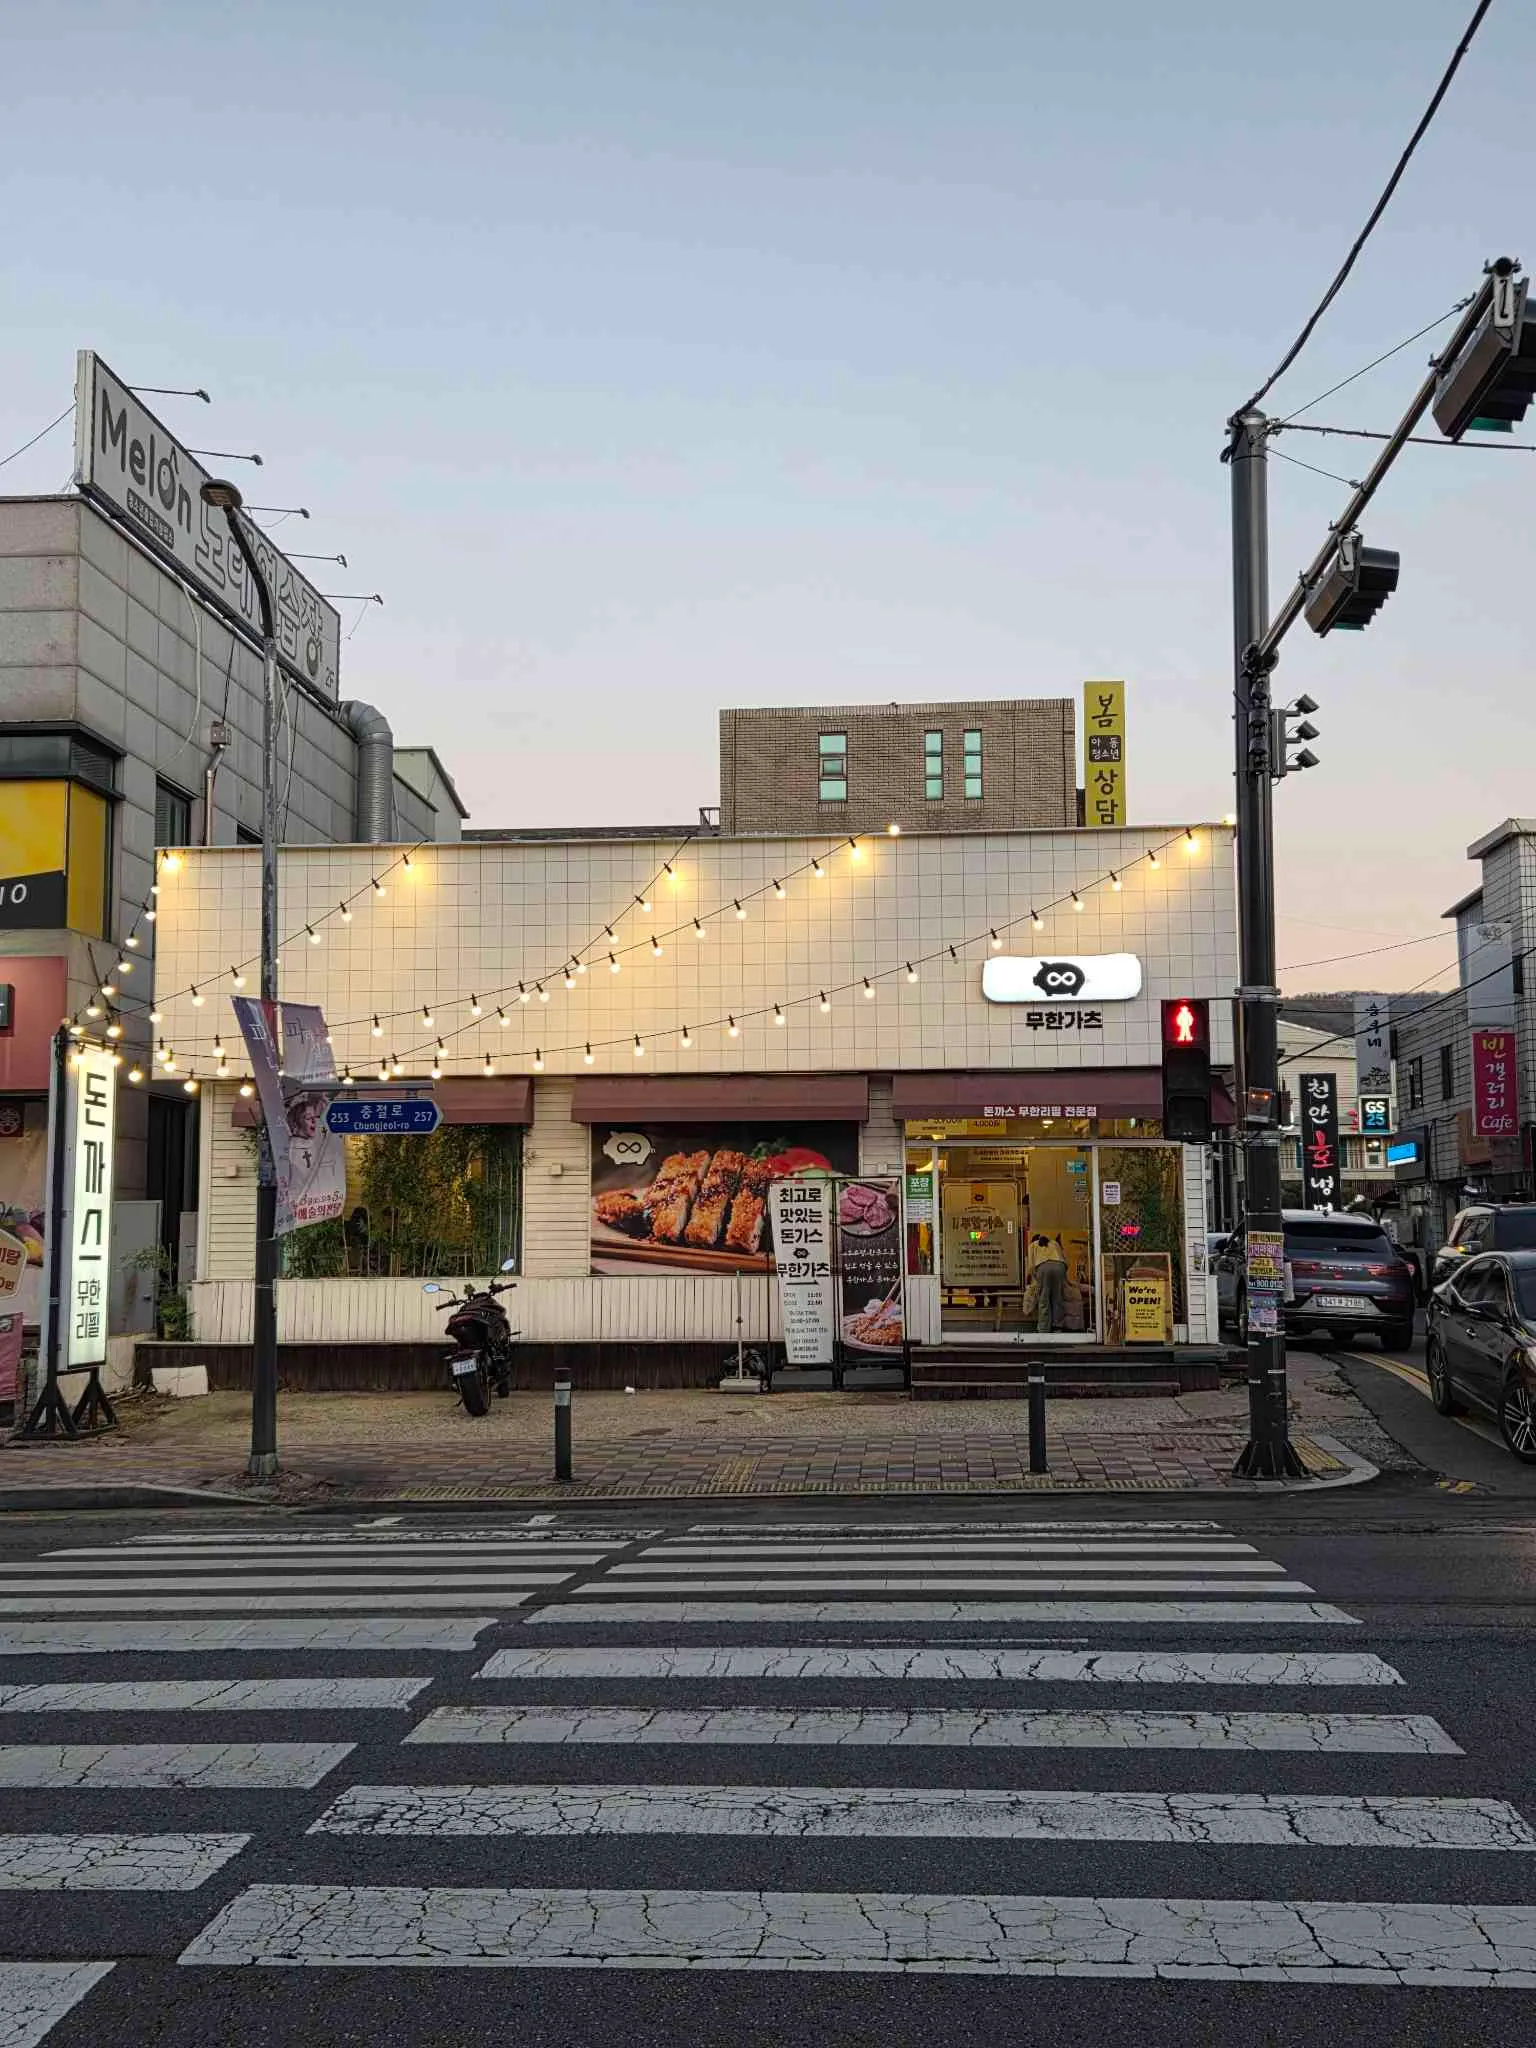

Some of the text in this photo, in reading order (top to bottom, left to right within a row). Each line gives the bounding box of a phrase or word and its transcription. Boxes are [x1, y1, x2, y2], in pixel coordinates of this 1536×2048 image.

[101, 387, 192, 535] Melon
[1091, 693, 1119, 729] 봄
[1091, 748, 1121, 760] 청소년
[1094, 769, 1119, 825] 상담
[1025, 1010, 1104, 1031] 무한가츠
[1485, 1062, 1506, 1109] 갤러리
[360, 1104, 403, 1120] 충절로
[983, 1105, 1098, 1118] 돈까스 무한리필 전문점
[1365, 1101, 1386, 1114] GS
[414, 1111, 433, 1122] 257
[1366, 1113, 1386, 1126] 25
[1481, 1114, 1513, 1133] Cafe
[353, 1121, 410, 1132] Chungjeol-ro
[80, 1072, 108, 1261] 돈까스
[779, 1187, 822, 1203] 최고로
[780, 1207, 823, 1224] 맛있는
[780, 1228, 823, 1244] 돈가스
[777, 1262, 830, 1278] 무한가츠
[75, 1279, 101, 1306] 무한
[1128, 1285, 1157, 1295] We're
[1129, 1296, 1161, 1305] OPEN!
[75, 1312, 101, 1340] 리필
